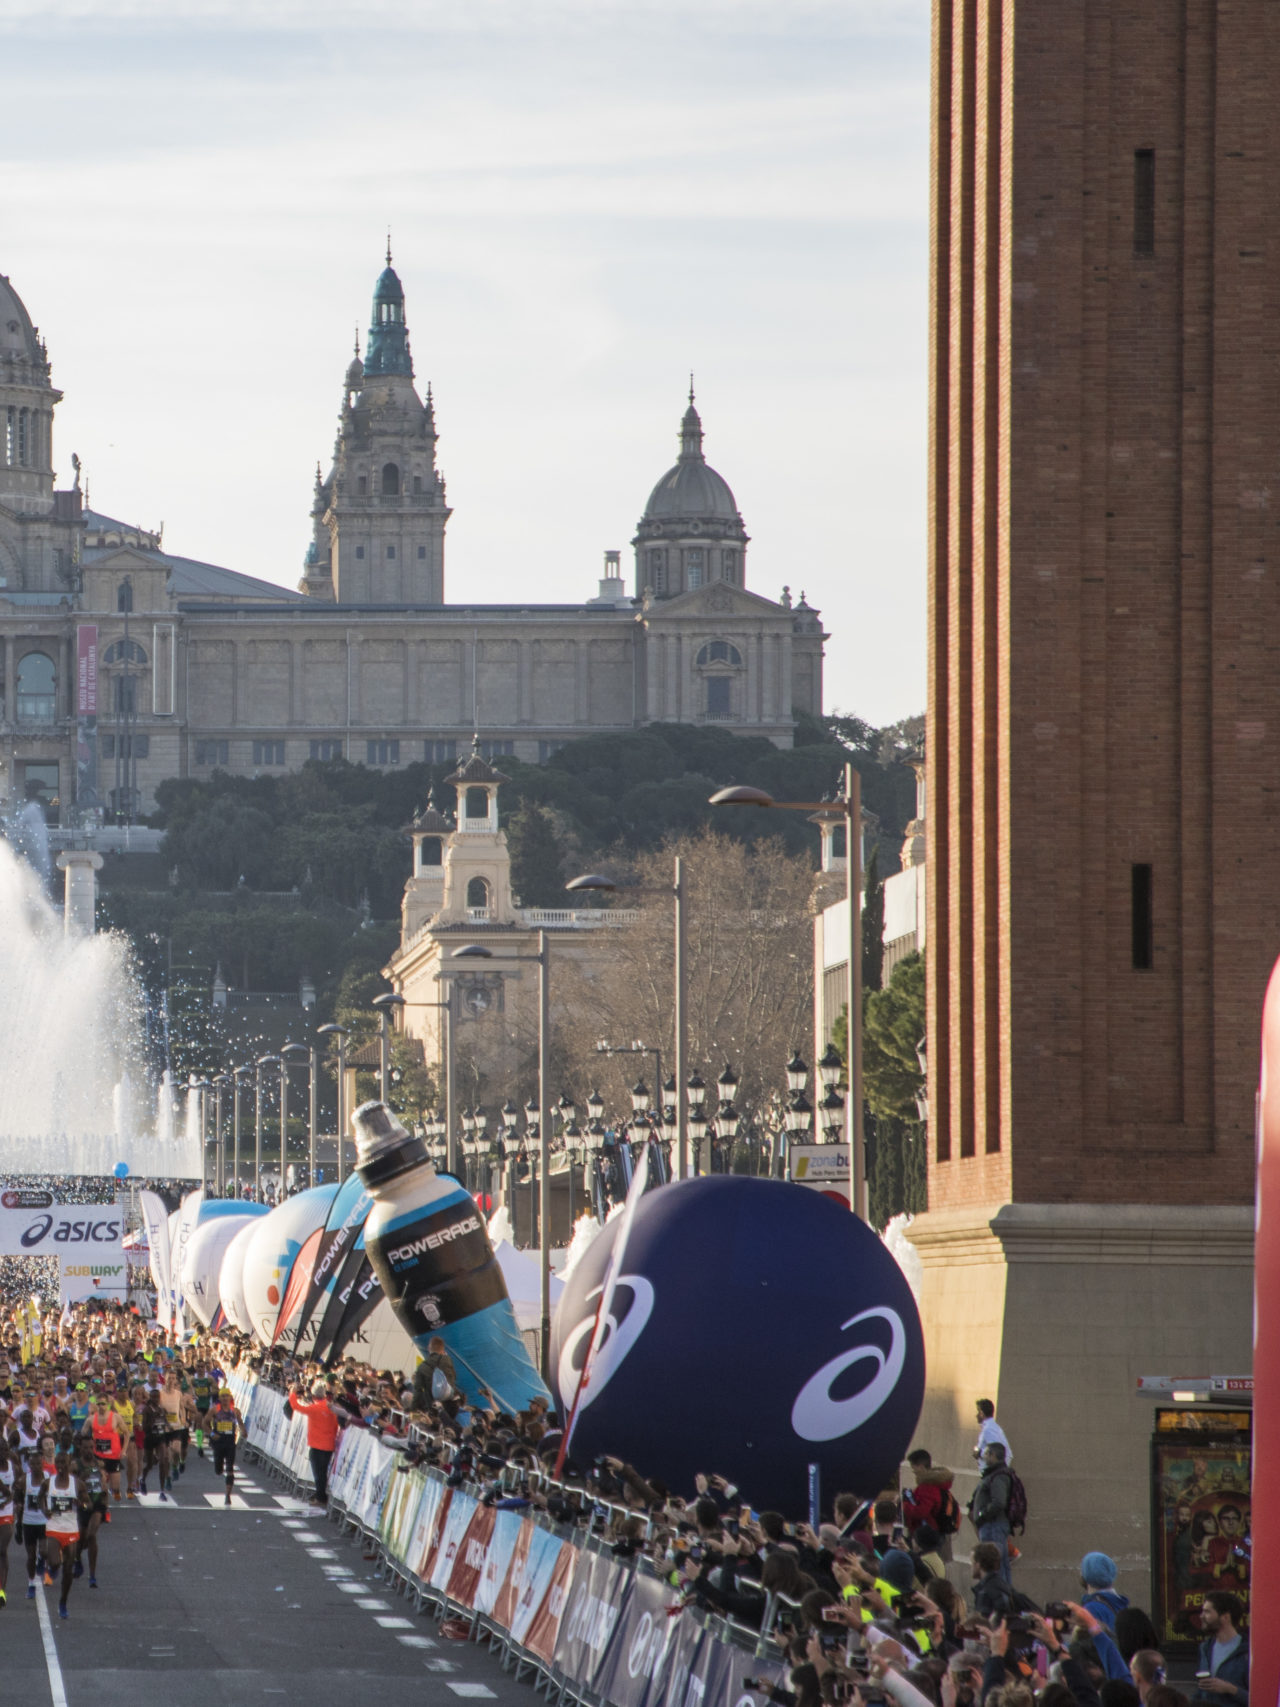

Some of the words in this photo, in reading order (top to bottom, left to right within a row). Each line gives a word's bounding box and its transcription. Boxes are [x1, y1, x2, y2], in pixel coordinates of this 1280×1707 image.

[808, 1152, 850, 1168] zonabu
[53, 1221, 121, 1242] asics
[313, 1190, 372, 1286] POWERAD
[387, 1216, 481, 1265] POWERADE
[63, 1265, 123, 1277] SUBWAY
